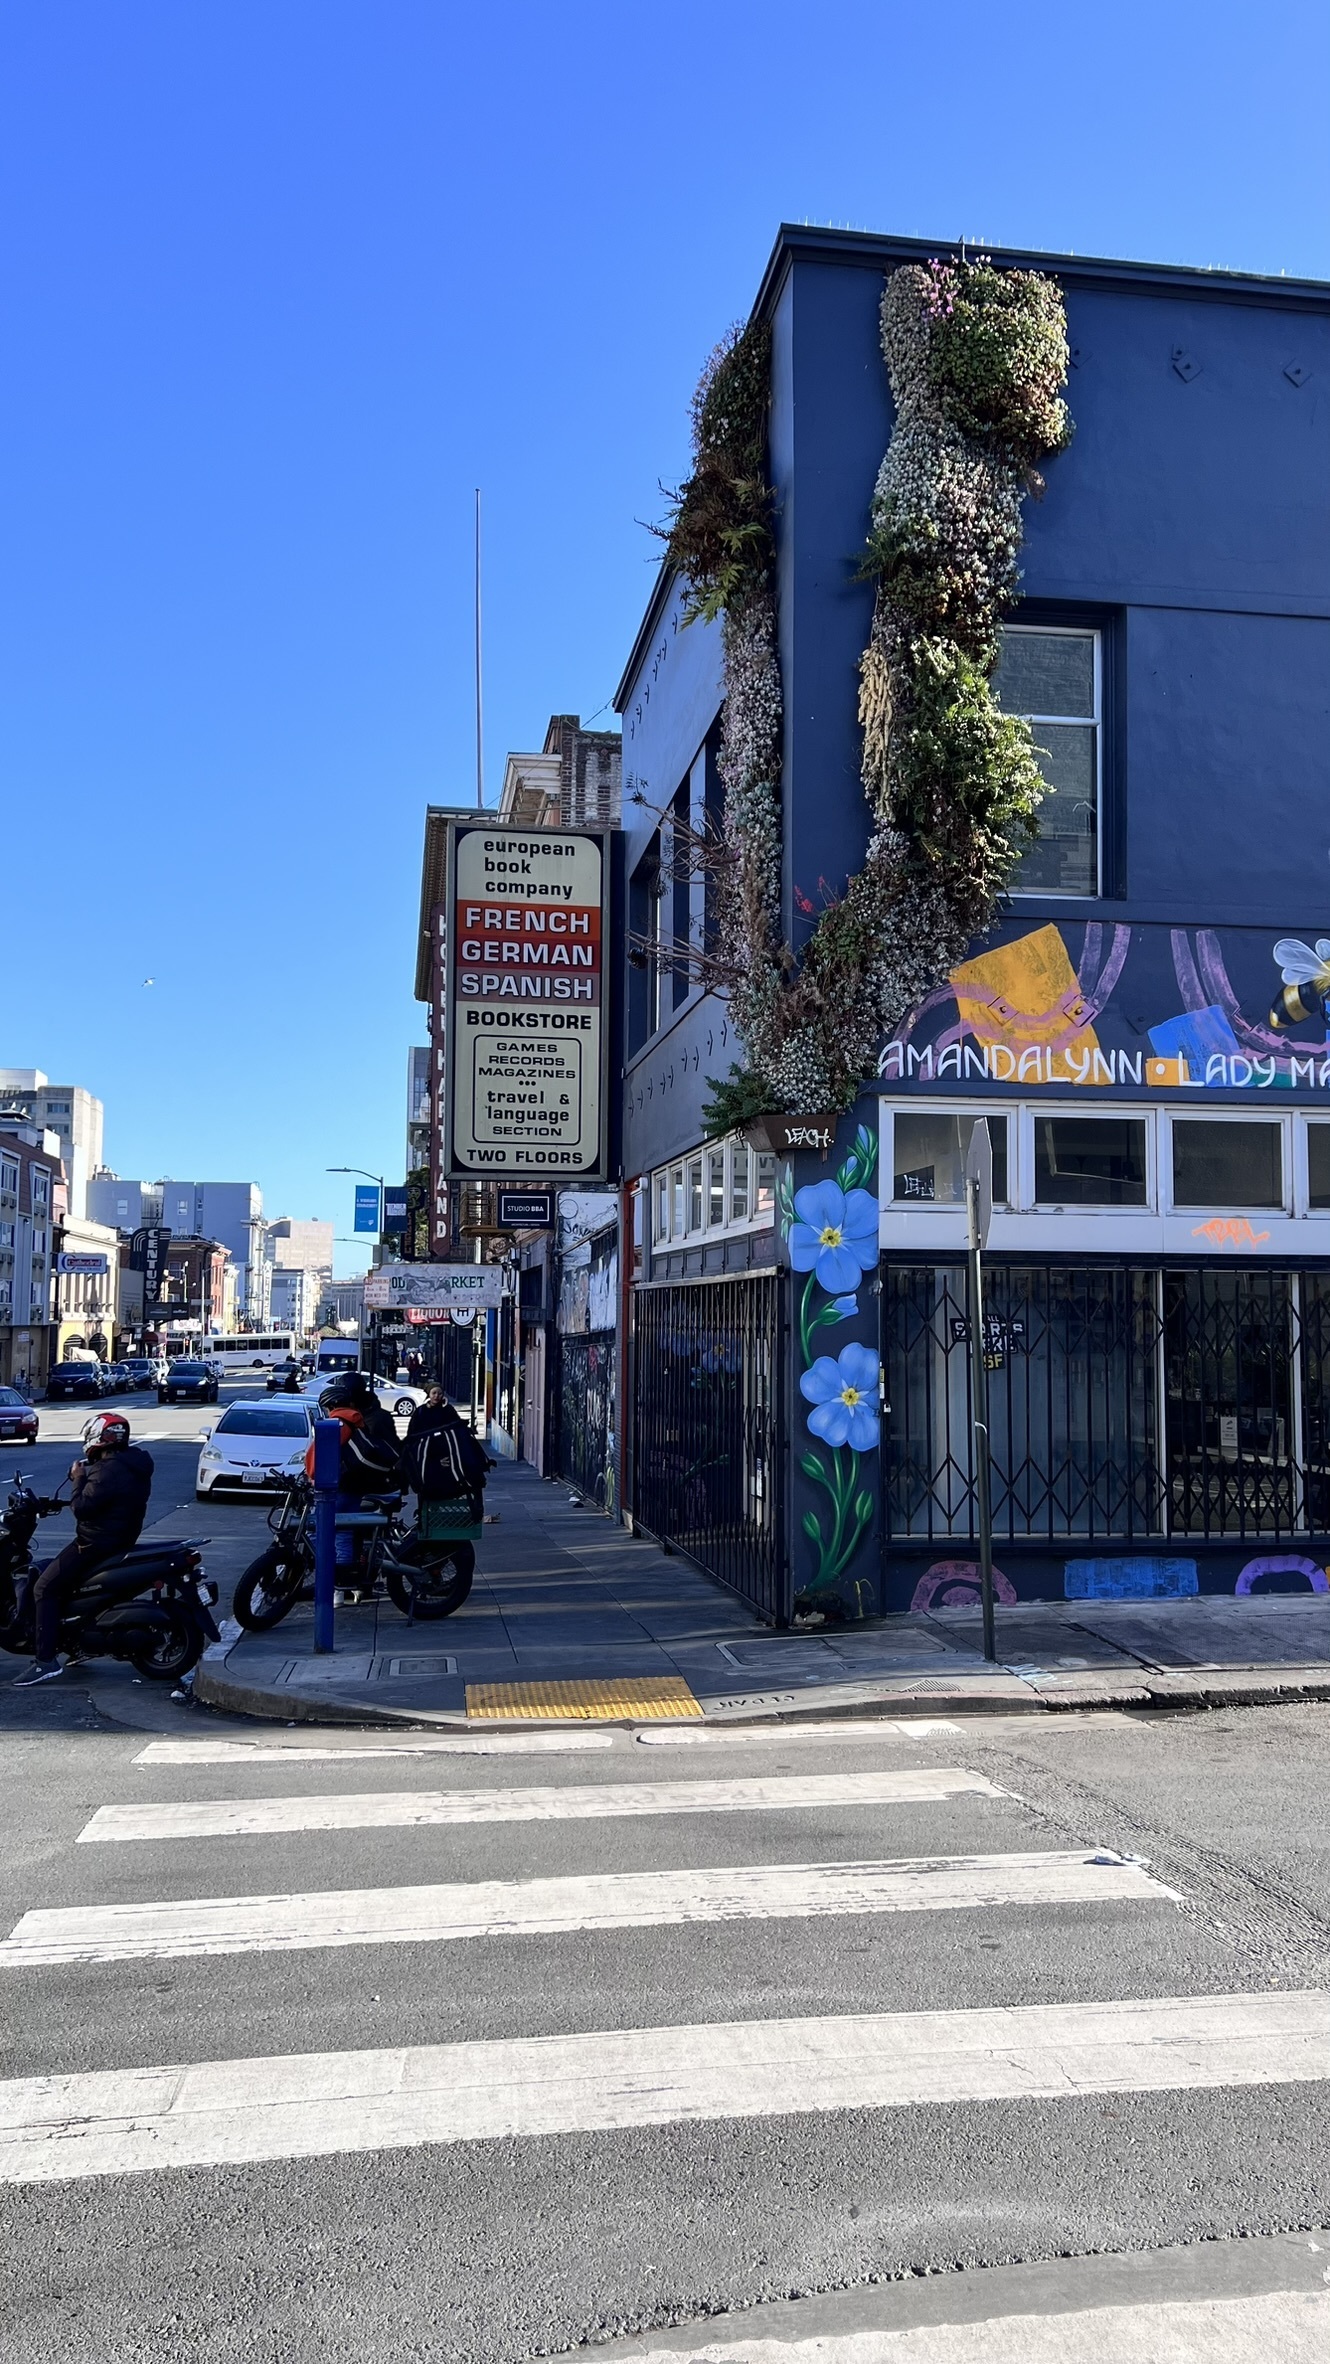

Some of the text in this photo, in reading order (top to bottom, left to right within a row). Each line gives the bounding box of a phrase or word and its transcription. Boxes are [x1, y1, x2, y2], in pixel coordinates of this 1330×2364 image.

[484, 840, 576, 858] european
[484, 857, 532, 874] book
[485, 881, 573, 900] company
[466, 907, 589, 934] FRENCH
[461, 940, 593, 966] GERMAN
[461, 973, 592, 999] SPANISH
[466, 1010, 592, 1030] BOOKSTORE
[497, 1042, 558, 1052] GAMES
[489, 1055, 565, 1066] RECORDS
[878, 1040, 1142, 1085] AMANDALYNN
[1178, 1050, 1276, 1088] LADY
[479, 1067, 576, 1079] MAGAZINES
[487, 1091, 570, 1105] travel &
[487, 1105, 569, 1125] language
[492, 1126, 562, 1136] SECTION
[466, 1149, 583, 1164] TWO FLOORS
[145, 1229, 159, 1300] CENTURY
